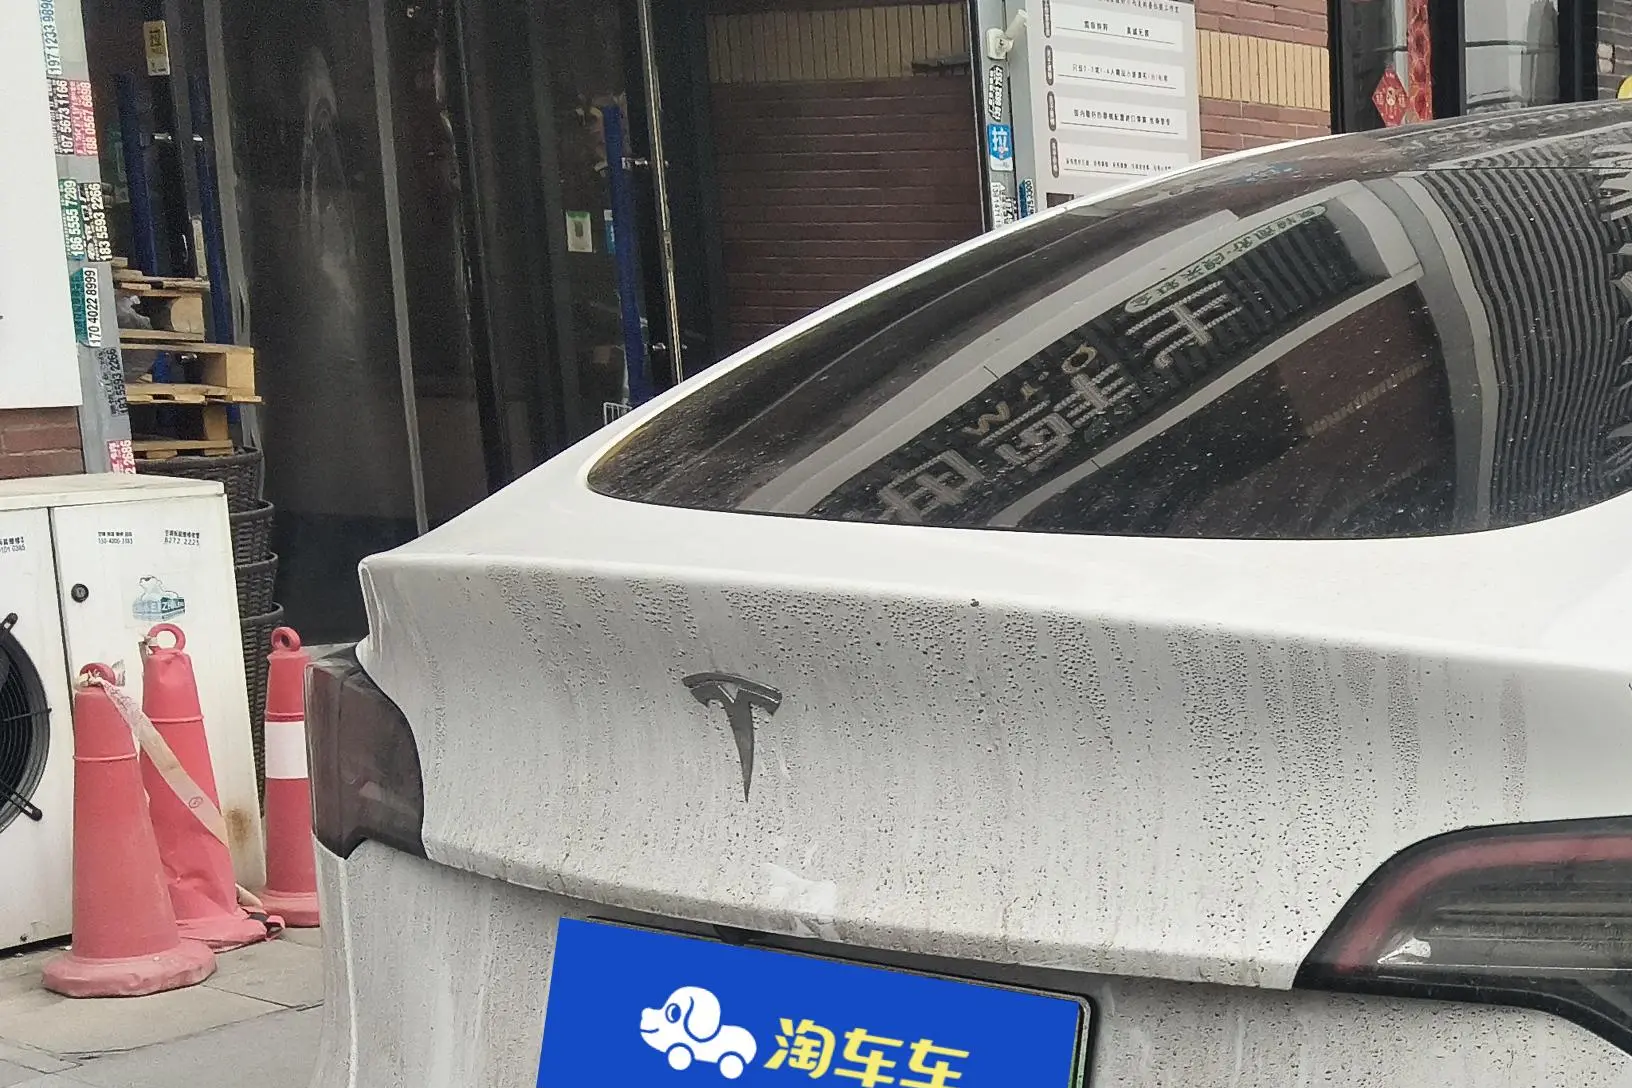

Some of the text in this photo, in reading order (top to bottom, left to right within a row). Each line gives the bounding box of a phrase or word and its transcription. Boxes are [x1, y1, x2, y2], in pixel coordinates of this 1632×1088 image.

[43, 25, 59, 50] 1233
[47, 54, 61, 73] 197
[55, 79, 70, 104] 1166
[58, 108, 72, 133] 5673
[88, 183, 104, 209] 2266
[66, 209, 81, 235] 5555
[93, 213, 109, 239] 5593
[69, 237, 84, 256] 186
[98, 241, 112, 262] 183
[83, 270, 98, 296] 8999
[86, 298, 99, 323] 4022
[88, 326, 101, 346] 170
[106, 348, 120, 372] 2266
[112, 372, 126, 396] 5593
